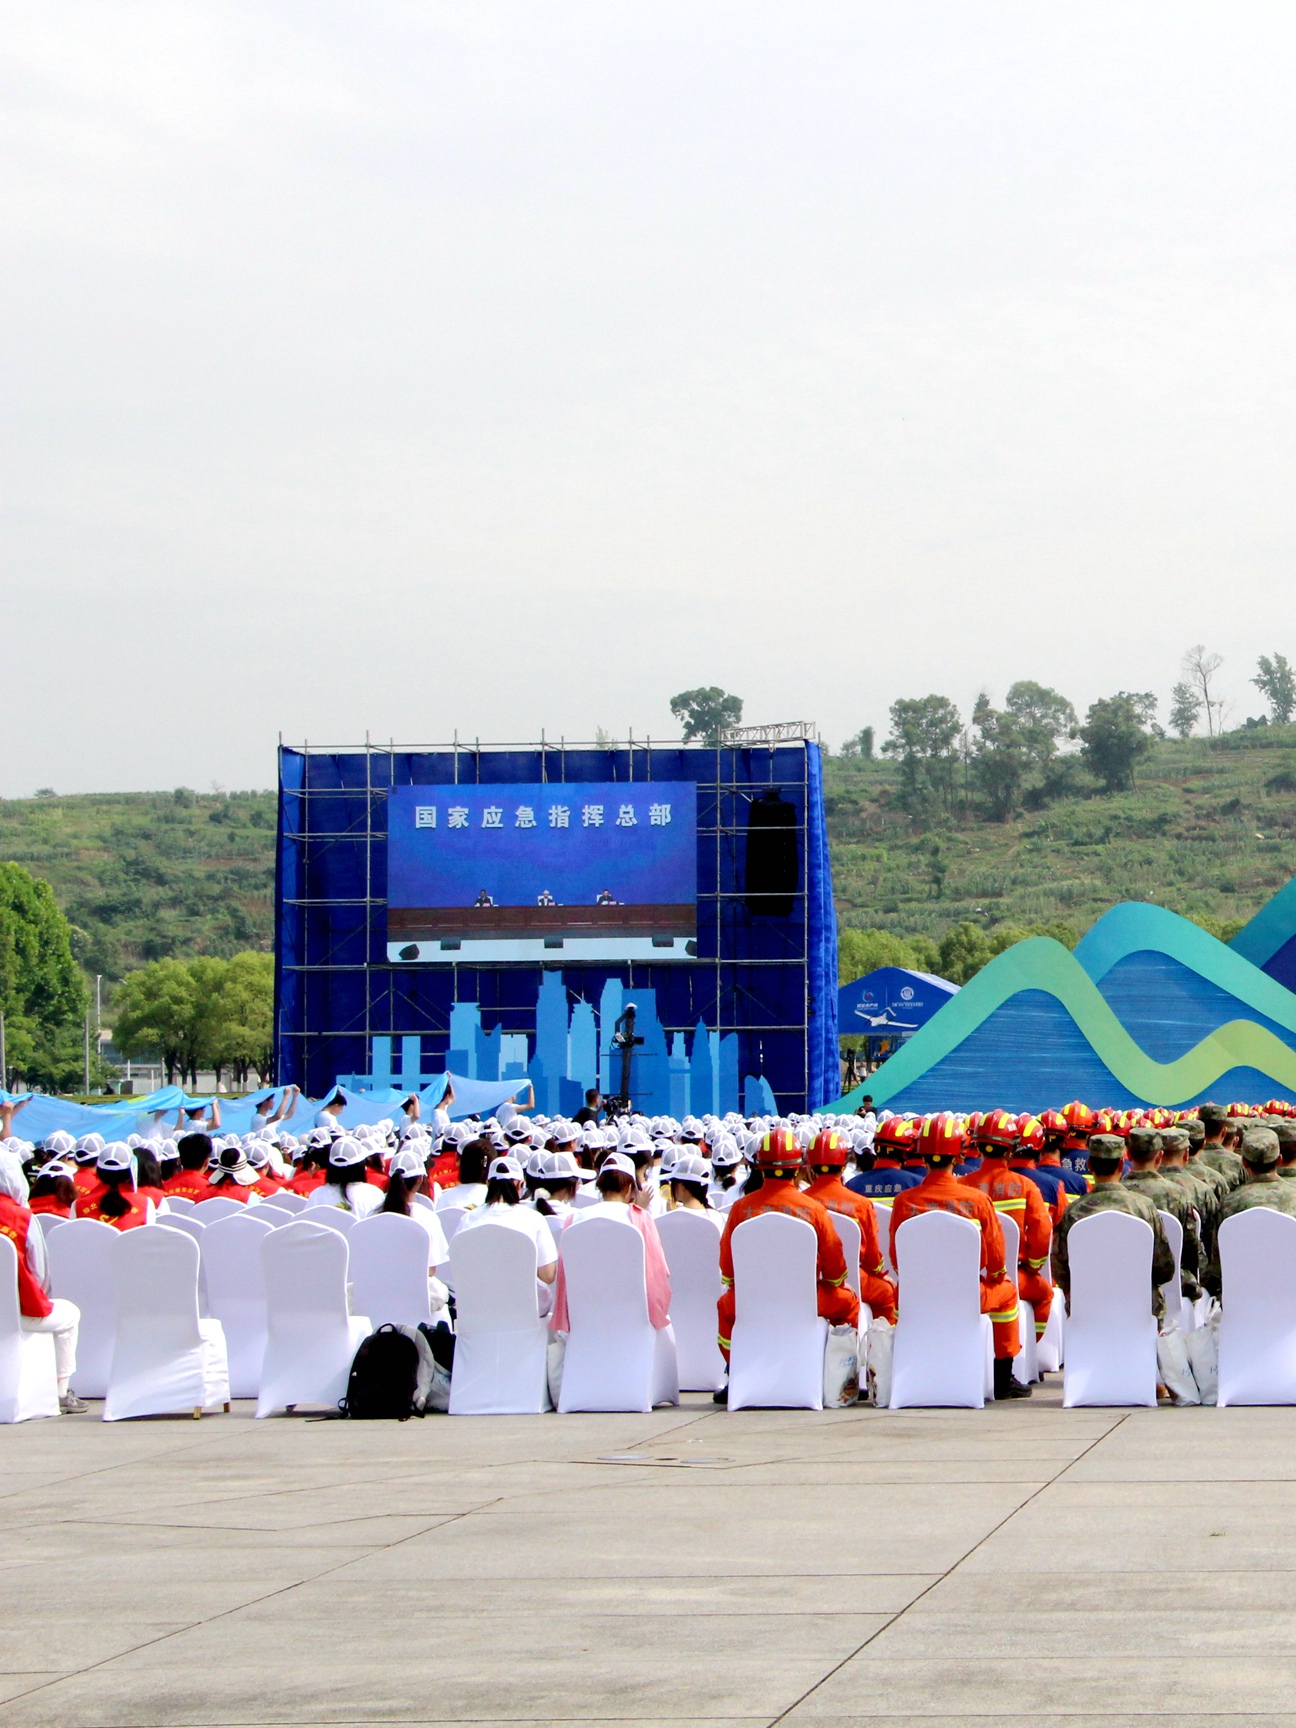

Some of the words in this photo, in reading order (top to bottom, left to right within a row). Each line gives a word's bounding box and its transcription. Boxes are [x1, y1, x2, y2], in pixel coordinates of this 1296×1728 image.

[415, 803, 672, 828] 国家应急指挥总部
[1061, 1157, 1090, 1172] 急救
[865, 1184, 902, 1194] 重庆应急
